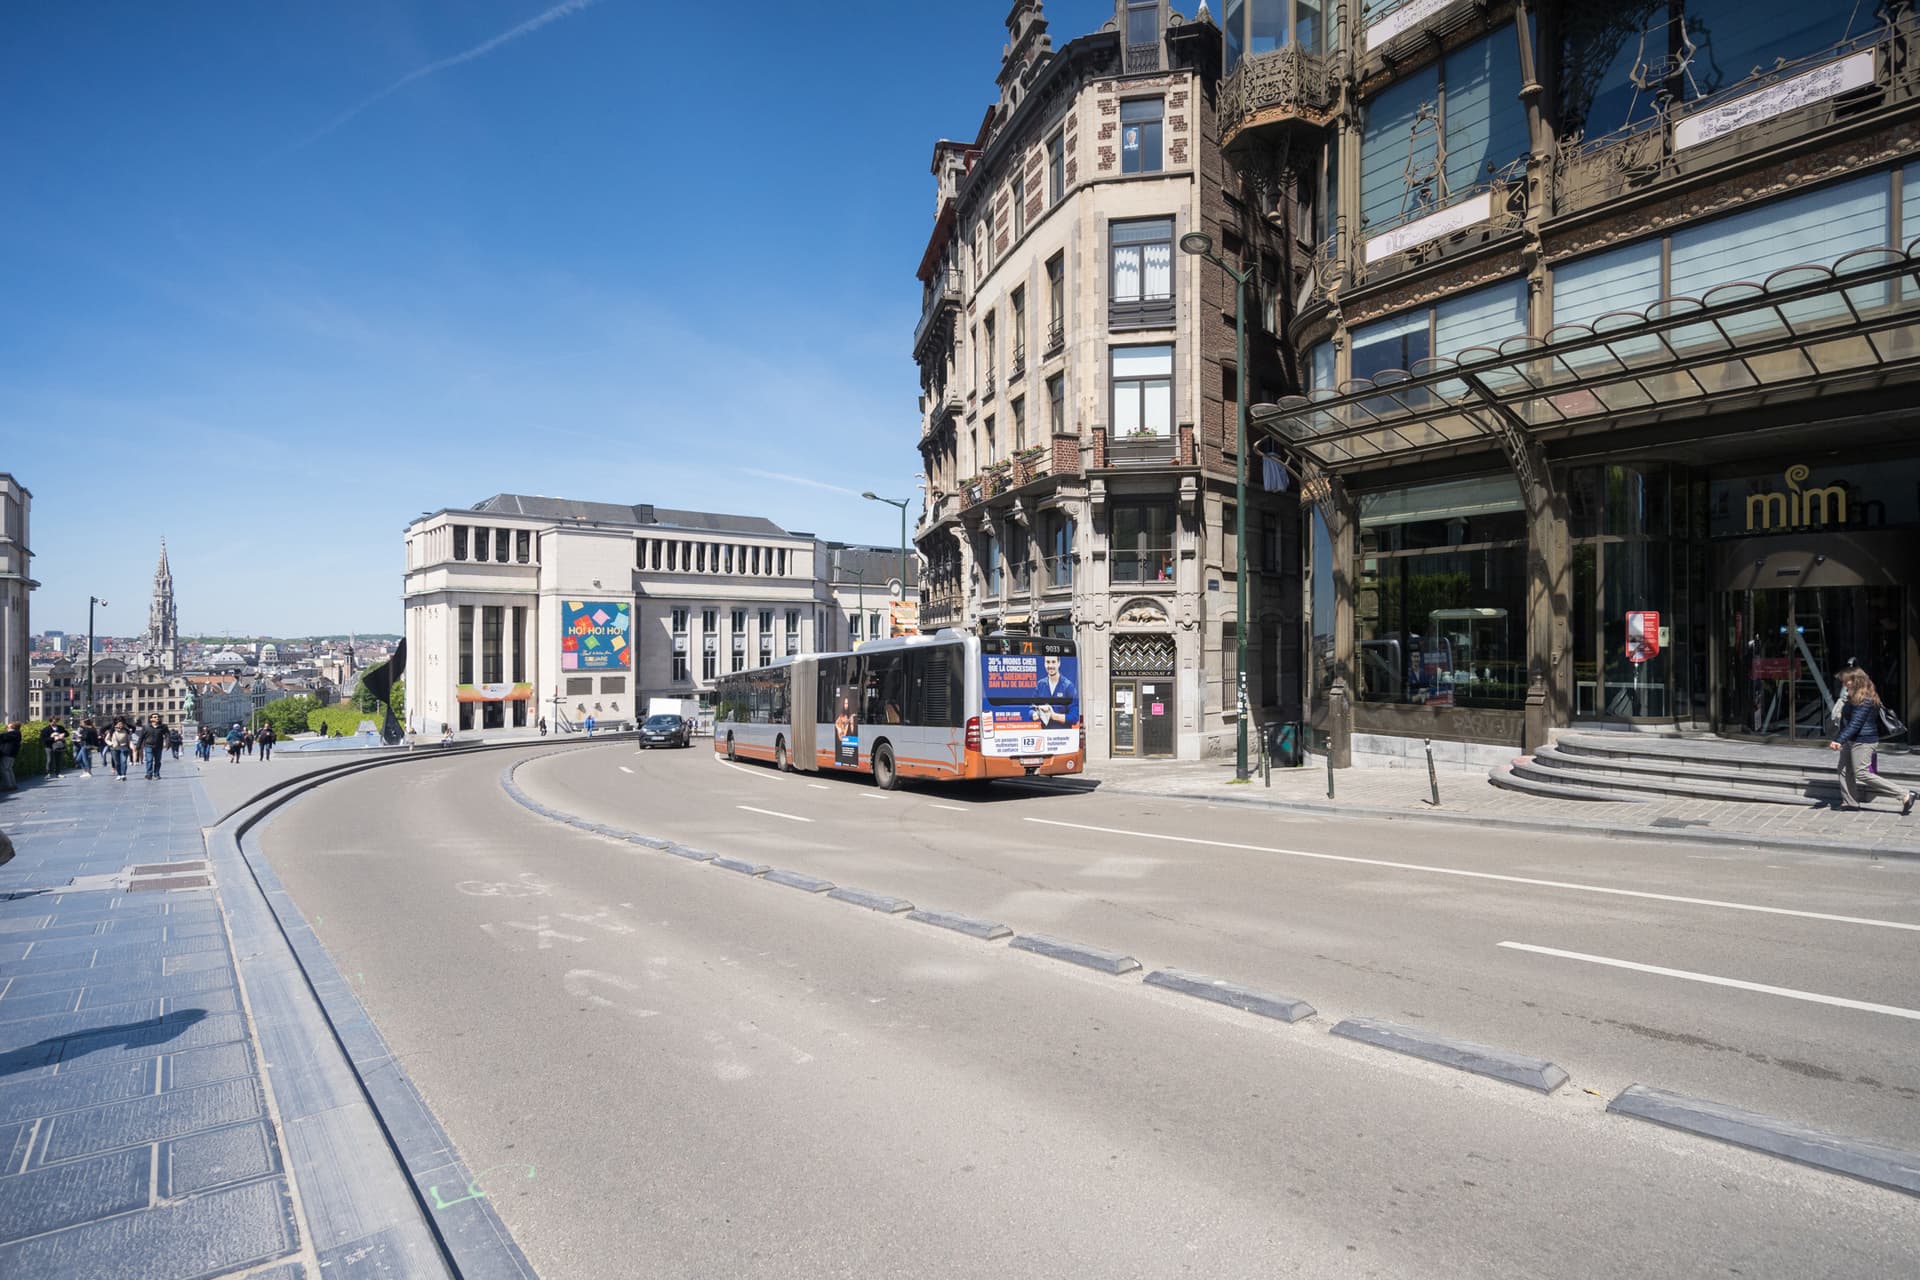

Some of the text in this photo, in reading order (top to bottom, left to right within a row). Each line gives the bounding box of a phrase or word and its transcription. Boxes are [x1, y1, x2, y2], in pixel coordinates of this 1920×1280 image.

[1746, 464, 1847, 530] mim
[568, 626, 624, 635] HO! HO! HO!
[1023, 641, 1033, 653] 71
[1023, 738, 1035, 746] 123
